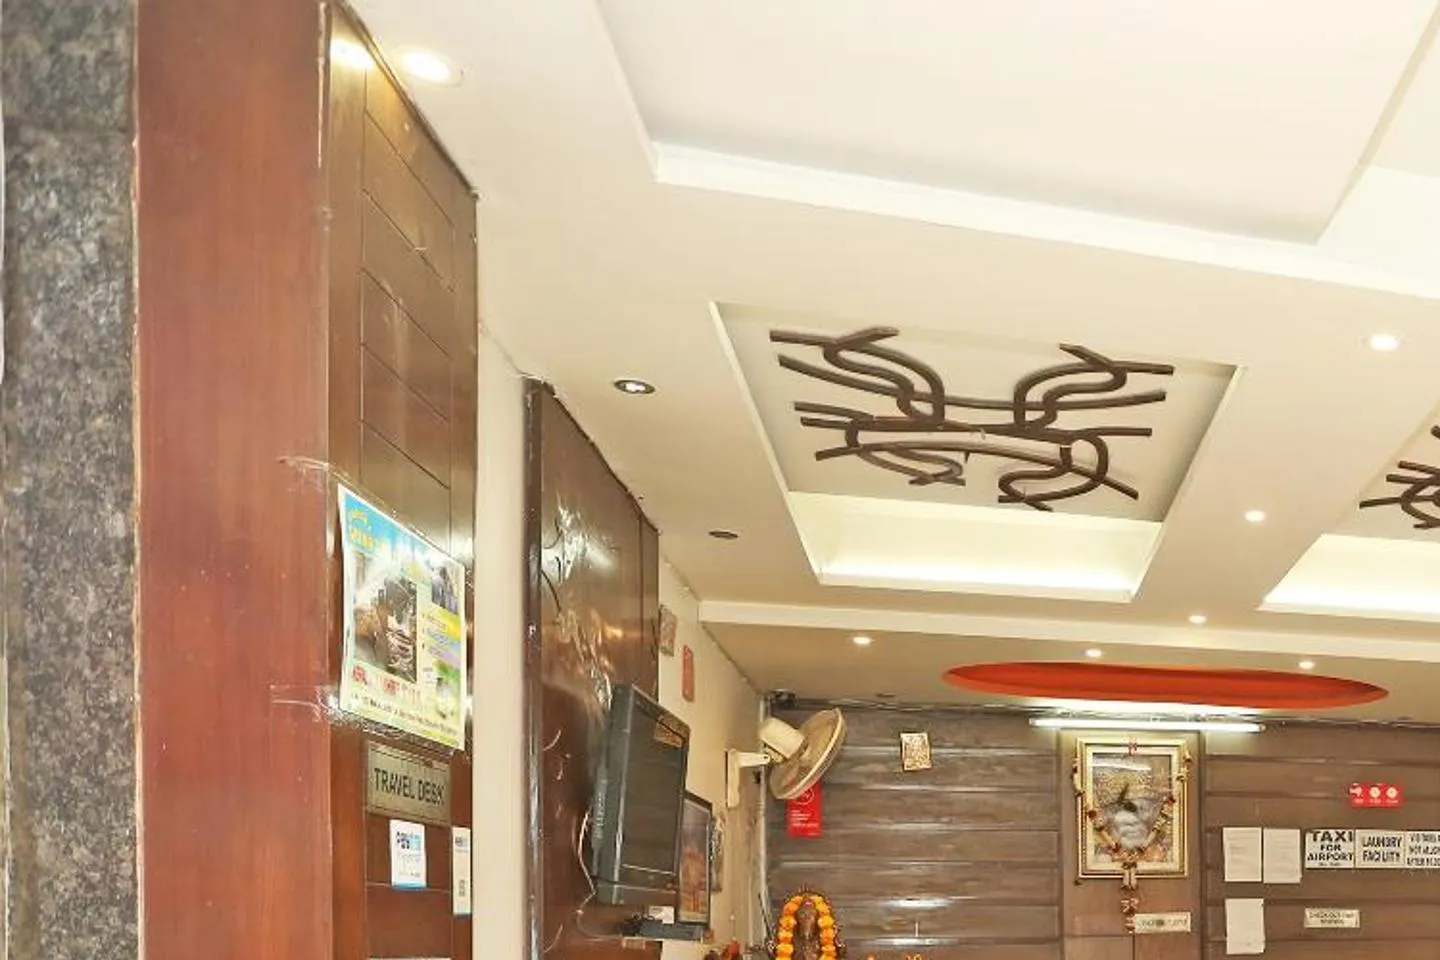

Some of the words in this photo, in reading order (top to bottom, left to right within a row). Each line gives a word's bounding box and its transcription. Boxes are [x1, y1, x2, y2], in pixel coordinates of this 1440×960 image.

[374, 767, 415, 800] TRAVEL
[418, 780, 446, 805] DESK
[1311, 831, 1353, 842] TAXI
[1362, 835, 1402, 848] LAUNDRY
[1320, 844, 1342, 852] FOR
[1307, 852, 1353, 862] AIRPORT
[1362, 850, 1401, 863] FACILITY
